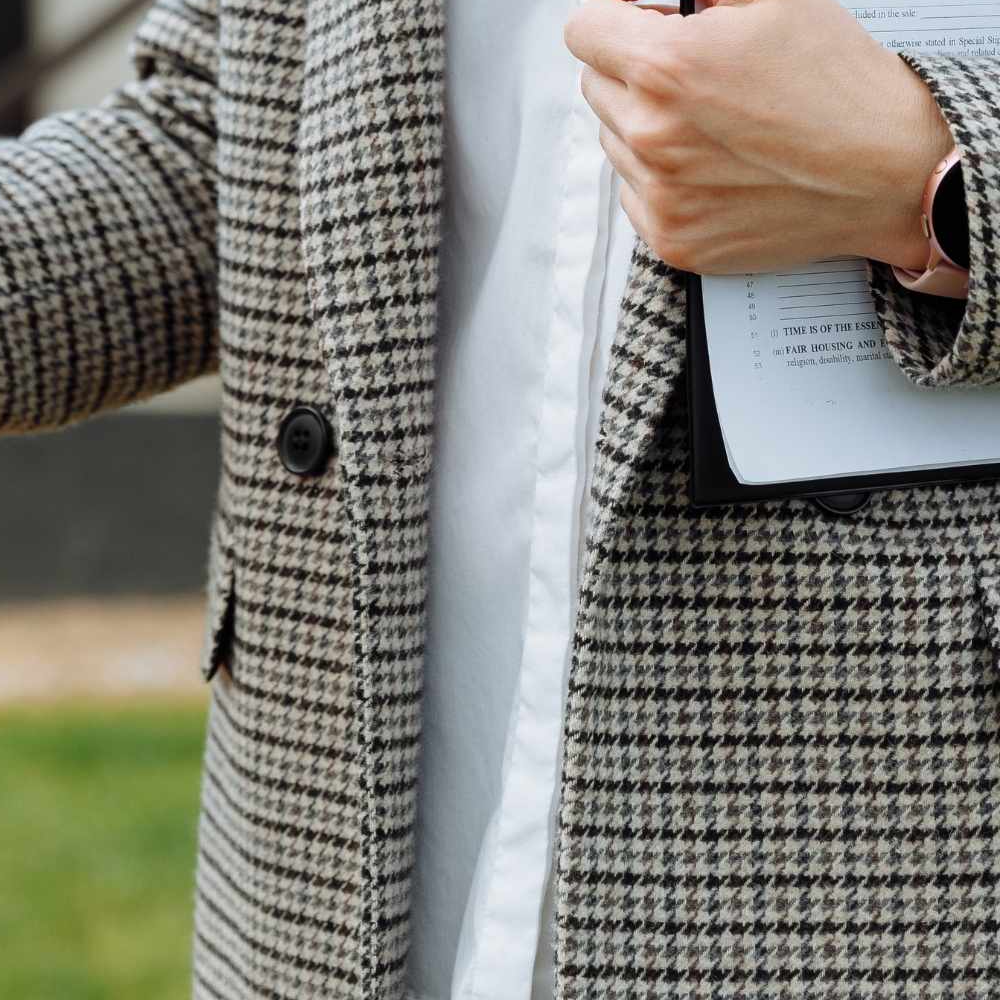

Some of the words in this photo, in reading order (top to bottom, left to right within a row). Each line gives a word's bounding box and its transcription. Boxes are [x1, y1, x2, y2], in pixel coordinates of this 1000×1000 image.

[783, 325, 807, 337] TIME
[809, 324, 818, 334] IS
[820, 323, 833, 334] OF
[834, 322, 851, 333] THE
[785, 343, 808, 355] FAIR
[811, 340, 853, 353] HOUSING
[857, 339, 876, 349] AND
